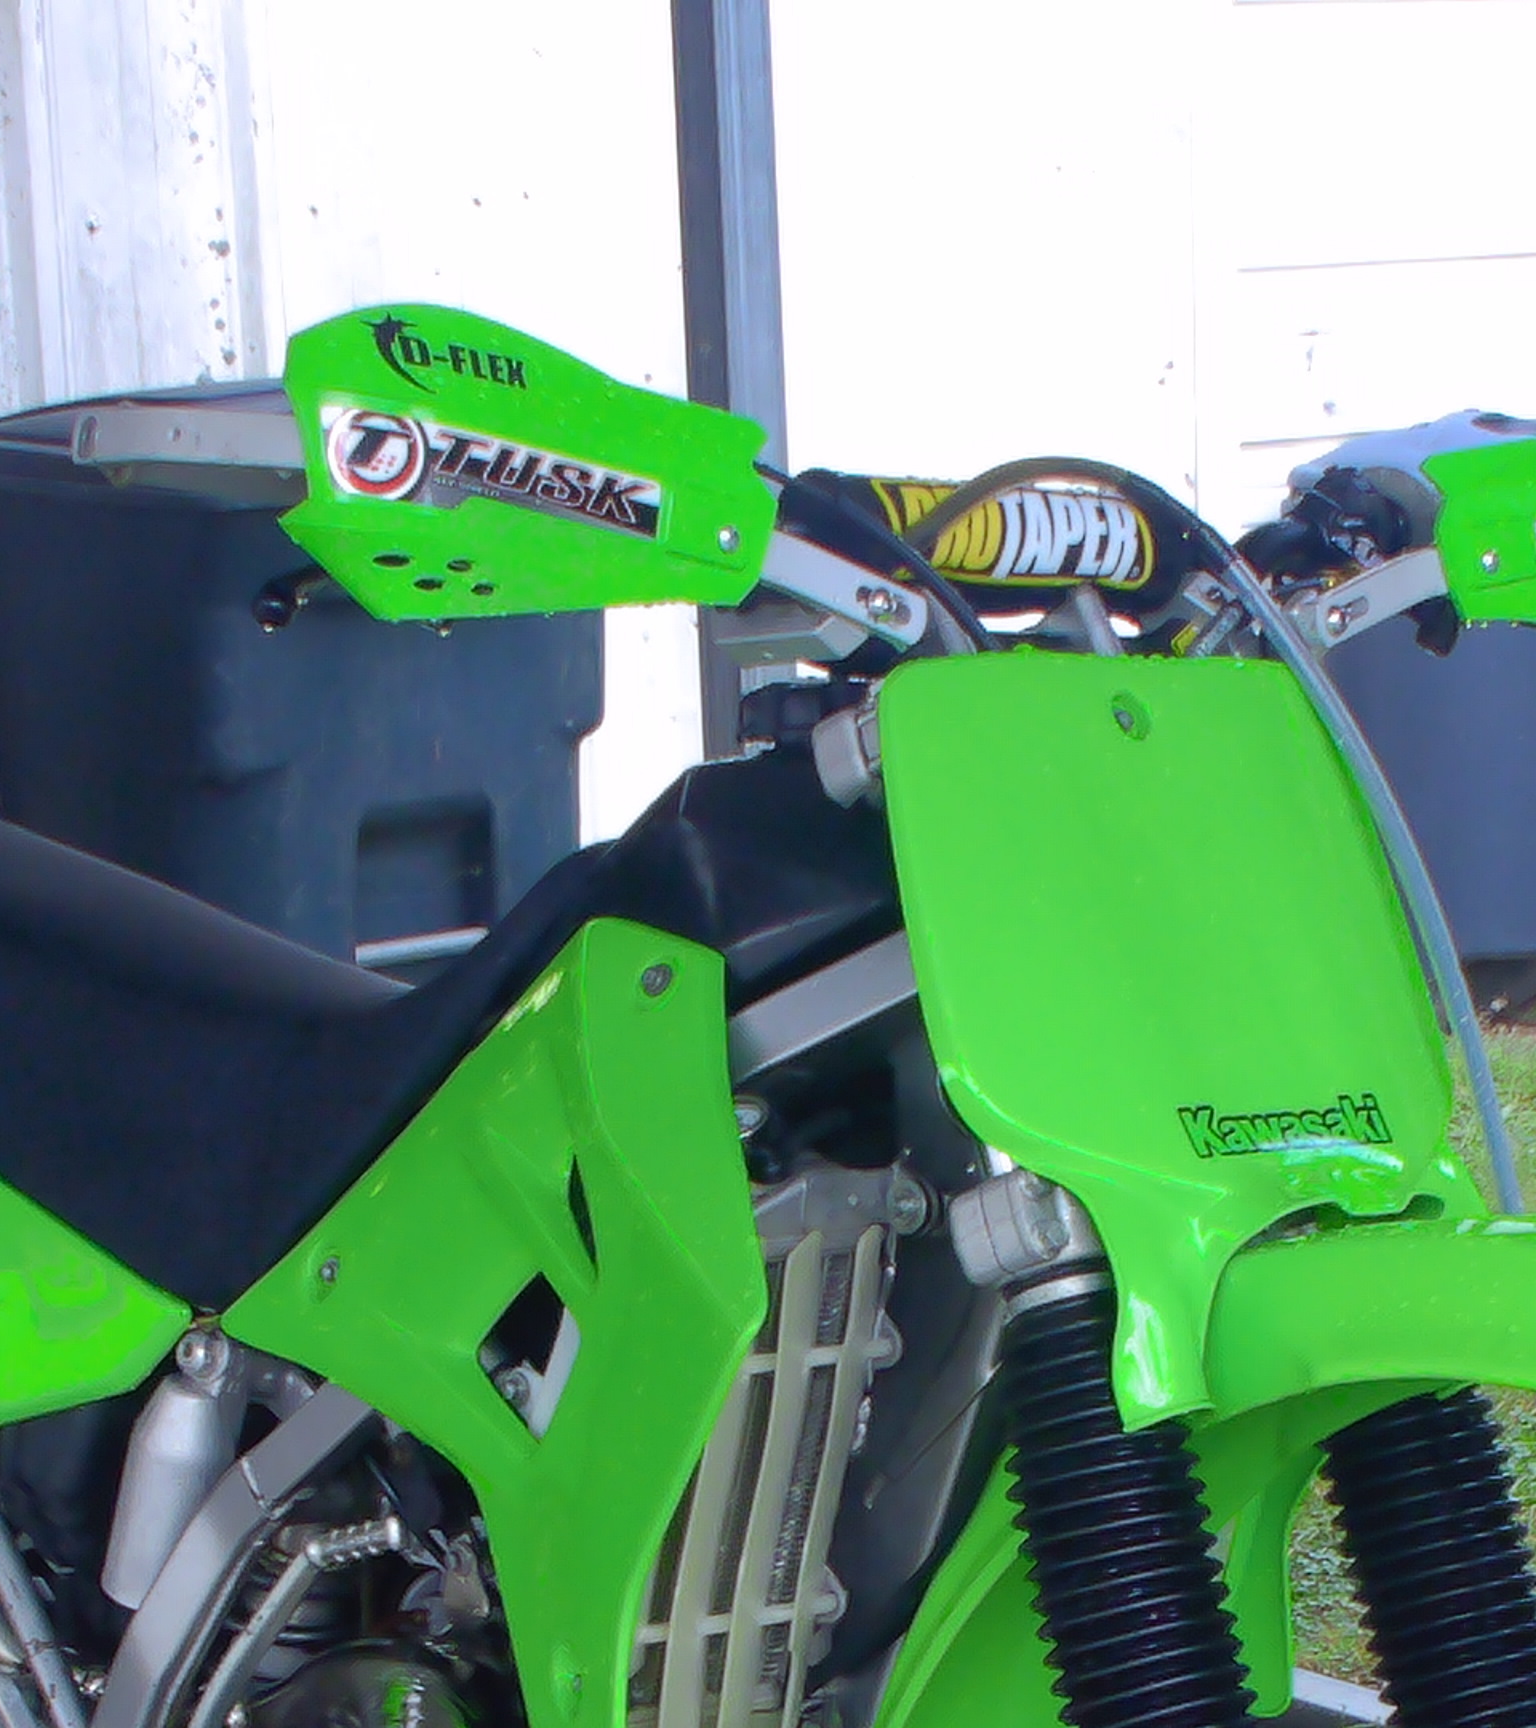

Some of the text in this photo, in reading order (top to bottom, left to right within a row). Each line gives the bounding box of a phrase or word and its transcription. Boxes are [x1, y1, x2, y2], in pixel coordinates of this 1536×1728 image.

[395, 333, 527, 391] D-FLEX
[433, 430, 658, 525] TUSK
[1177, 1092, 1394, 1159] Kawasaki
